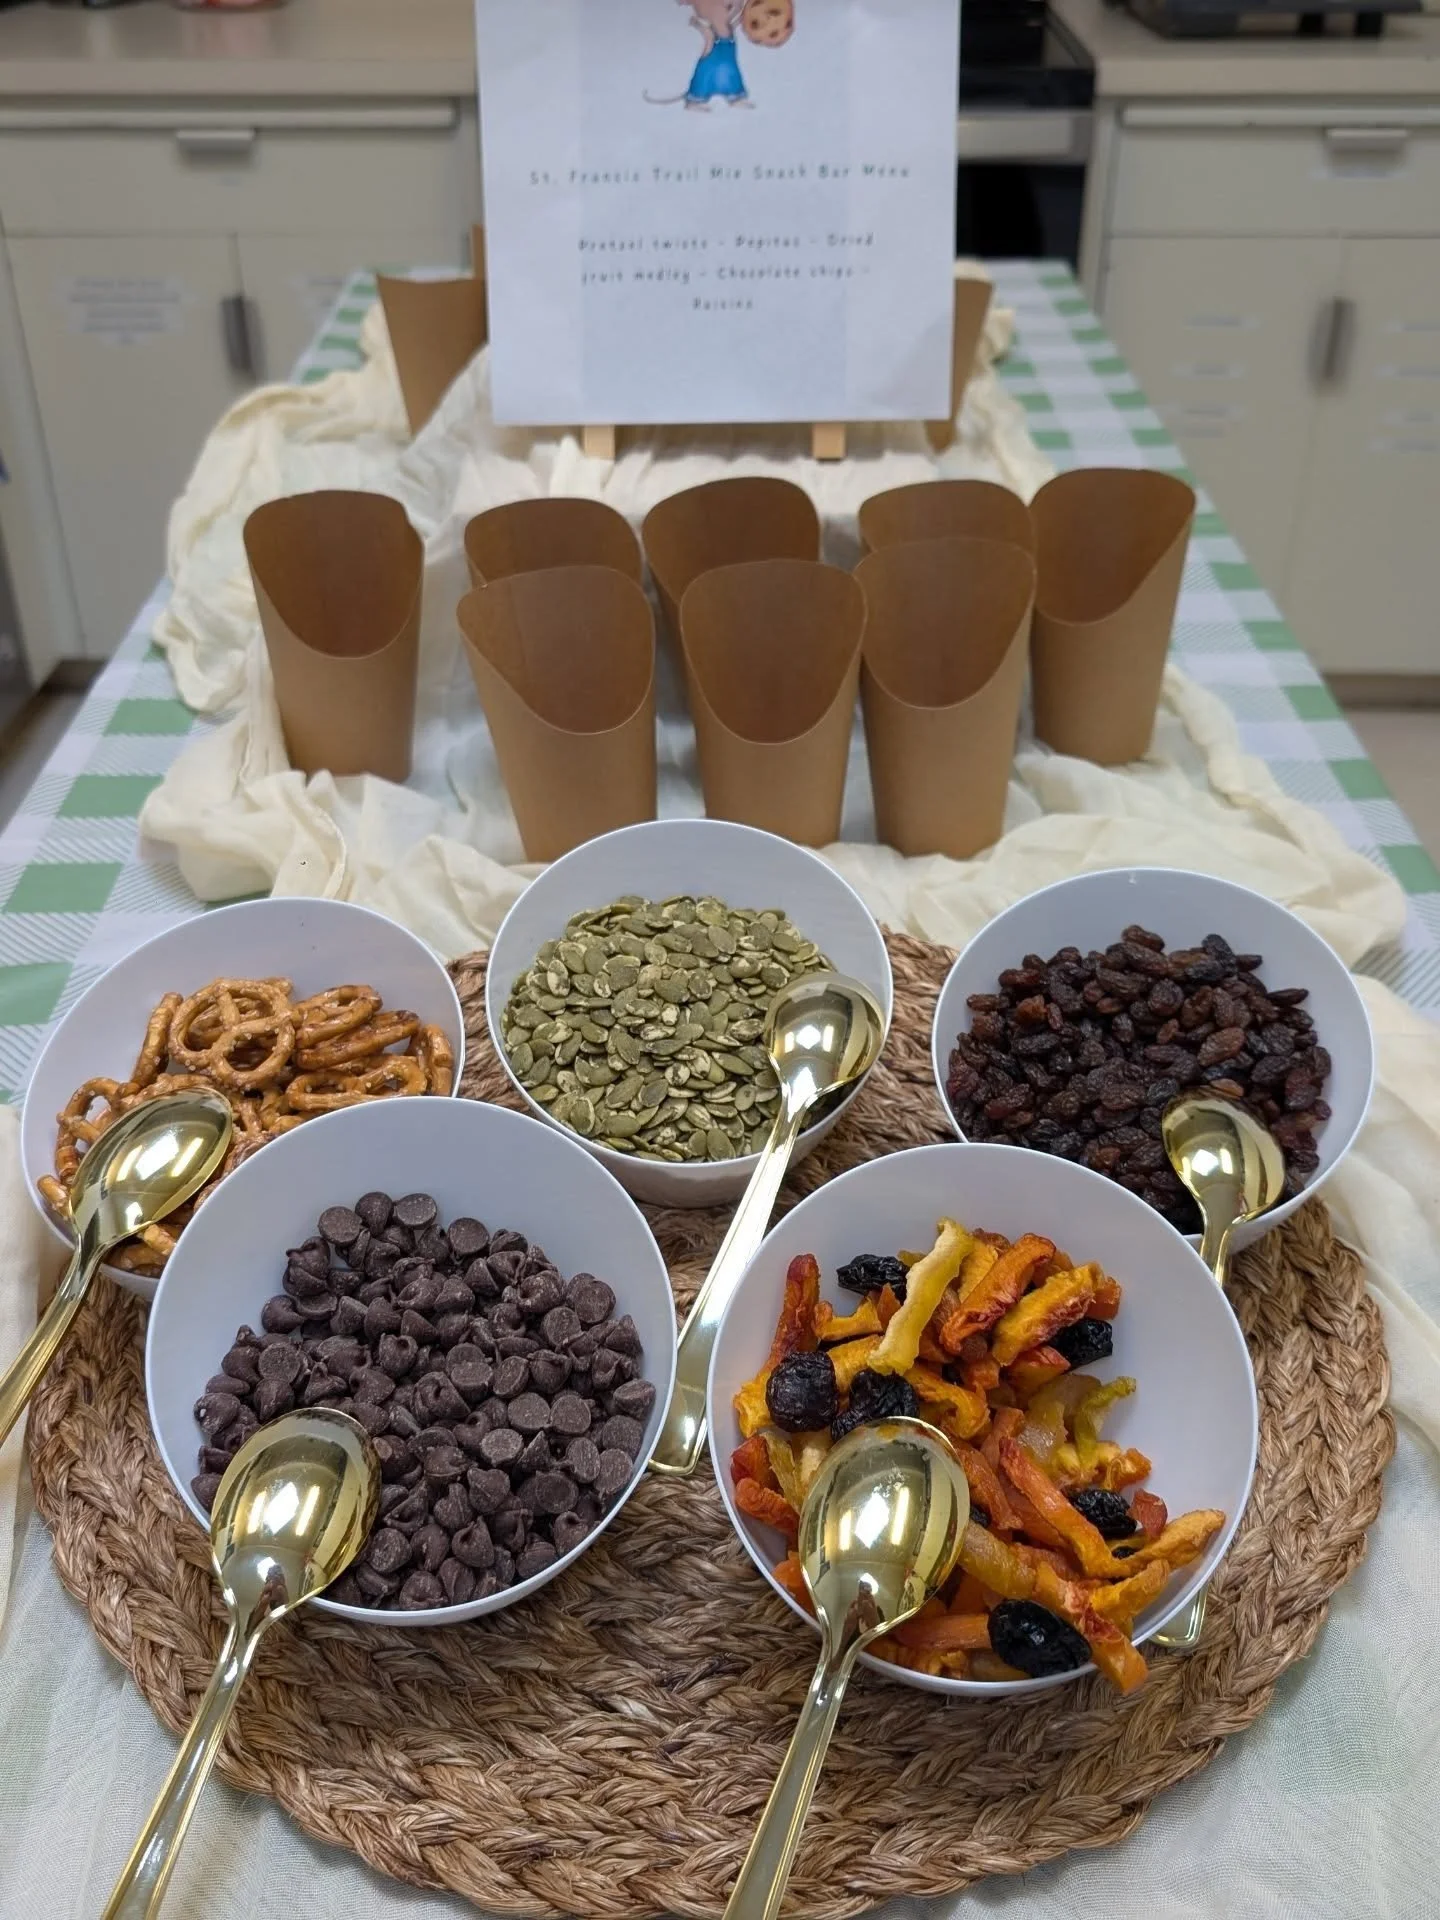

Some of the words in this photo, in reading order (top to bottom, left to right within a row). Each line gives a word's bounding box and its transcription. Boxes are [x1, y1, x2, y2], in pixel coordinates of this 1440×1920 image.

[569, 167, 640, 184] Francis
[652, 164, 699, 182] Trail
[709, 164, 743, 181] Mix
[752, 162, 807, 180] Snack
[818, 164, 850, 178] Bar
[863, 164, 911, 178] Menu
[577, 237, 642, 252] Pretzel
[652, 237, 707, 250] twists
[735, 233, 801, 251] Pepitas
[826, 231, 875, 247] Dried
[580, 265, 624, 287] fruit
[633, 265, 691, 284] medley
[717, 264, 800, 280] Chocolate
[809, 263, 855, 280] chips
[692, 296, 754, 311] Raisins
